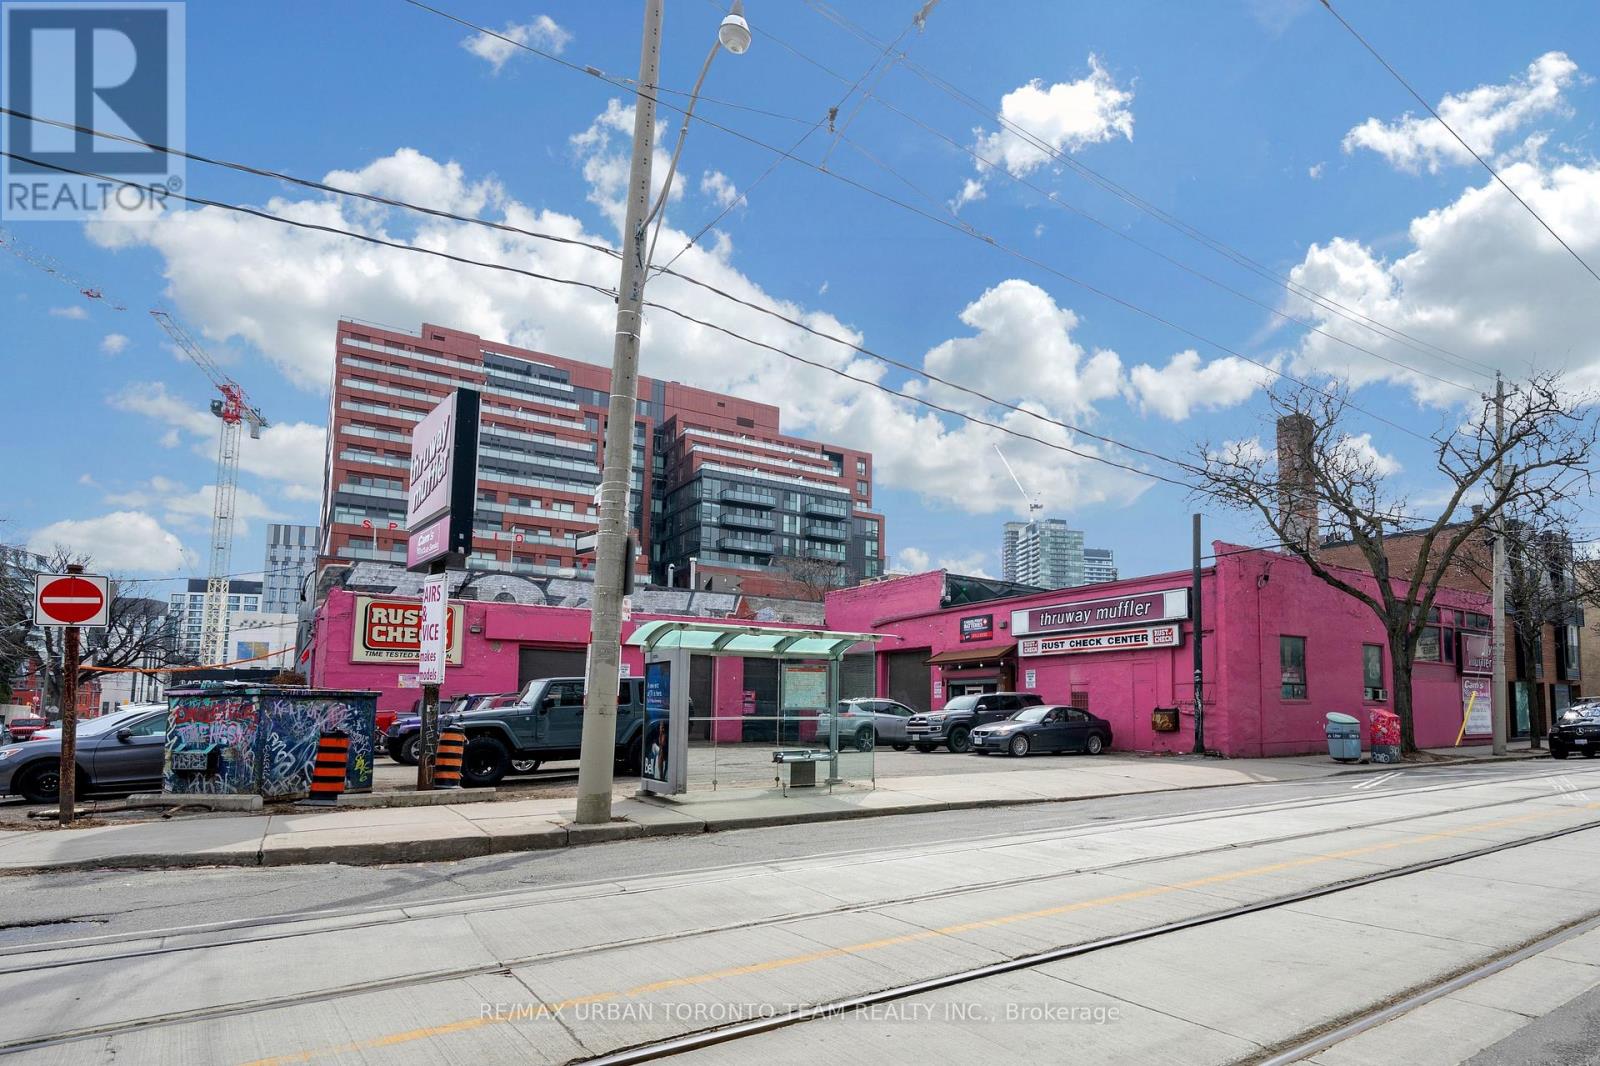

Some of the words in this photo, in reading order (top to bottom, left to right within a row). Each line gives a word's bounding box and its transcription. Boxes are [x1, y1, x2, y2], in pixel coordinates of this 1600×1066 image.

[412, 456, 449, 514] muffler
[424, 585, 442, 603] AIRS
[371, 607, 422, 626] RUS
[1039, 609, 1091, 626] thruway
[1096, 600, 1151, 620] muffler
[371, 626, 449, 644] CHE
[422, 624, 439, 641] VICE
[1041, 640, 1065, 650] RUST
[1069, 638, 1102, 647] CHECK
[1107, 633, 1149, 645] CENTER
[365, 650, 384, 658] TIME
